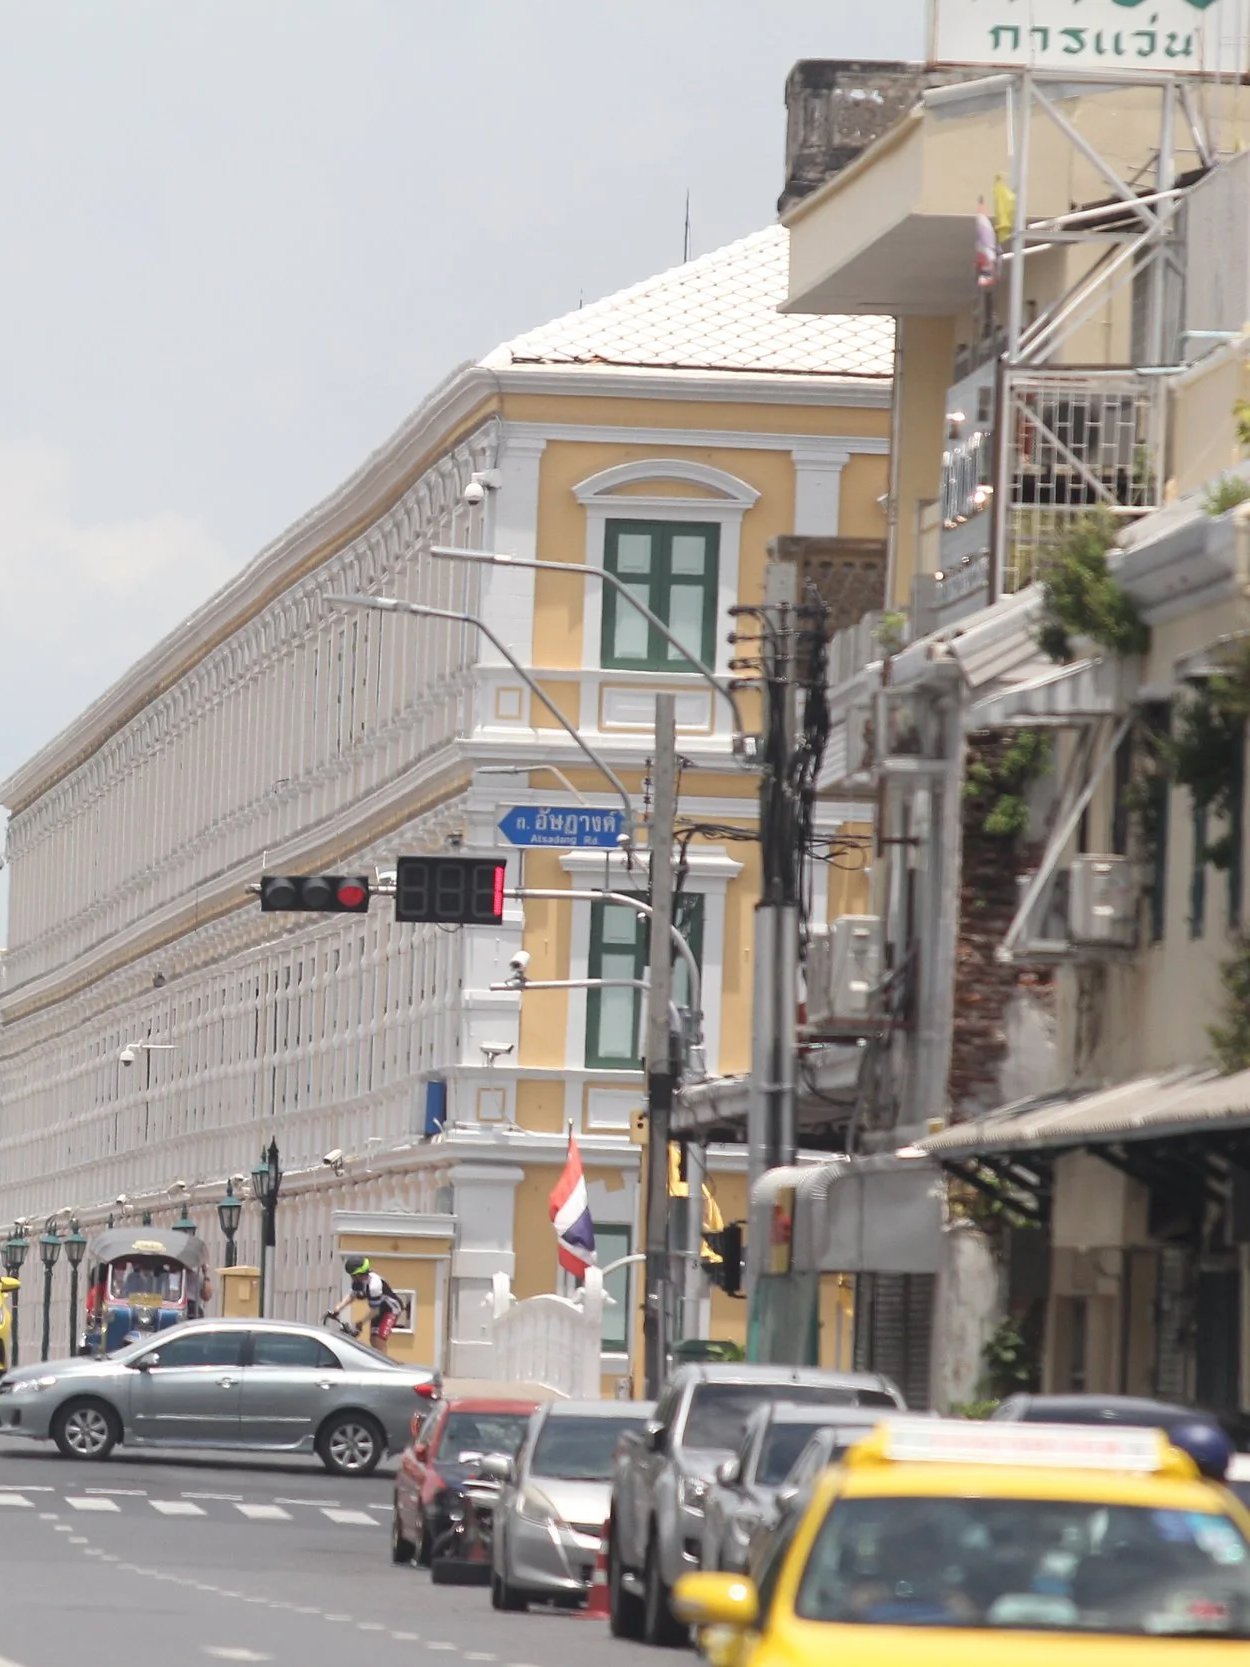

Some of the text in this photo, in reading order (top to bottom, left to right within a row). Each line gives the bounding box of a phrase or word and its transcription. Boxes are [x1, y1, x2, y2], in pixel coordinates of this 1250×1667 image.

[988, 13, 1194, 57] การแว่น
[516, 816, 530, 830] ถ.
